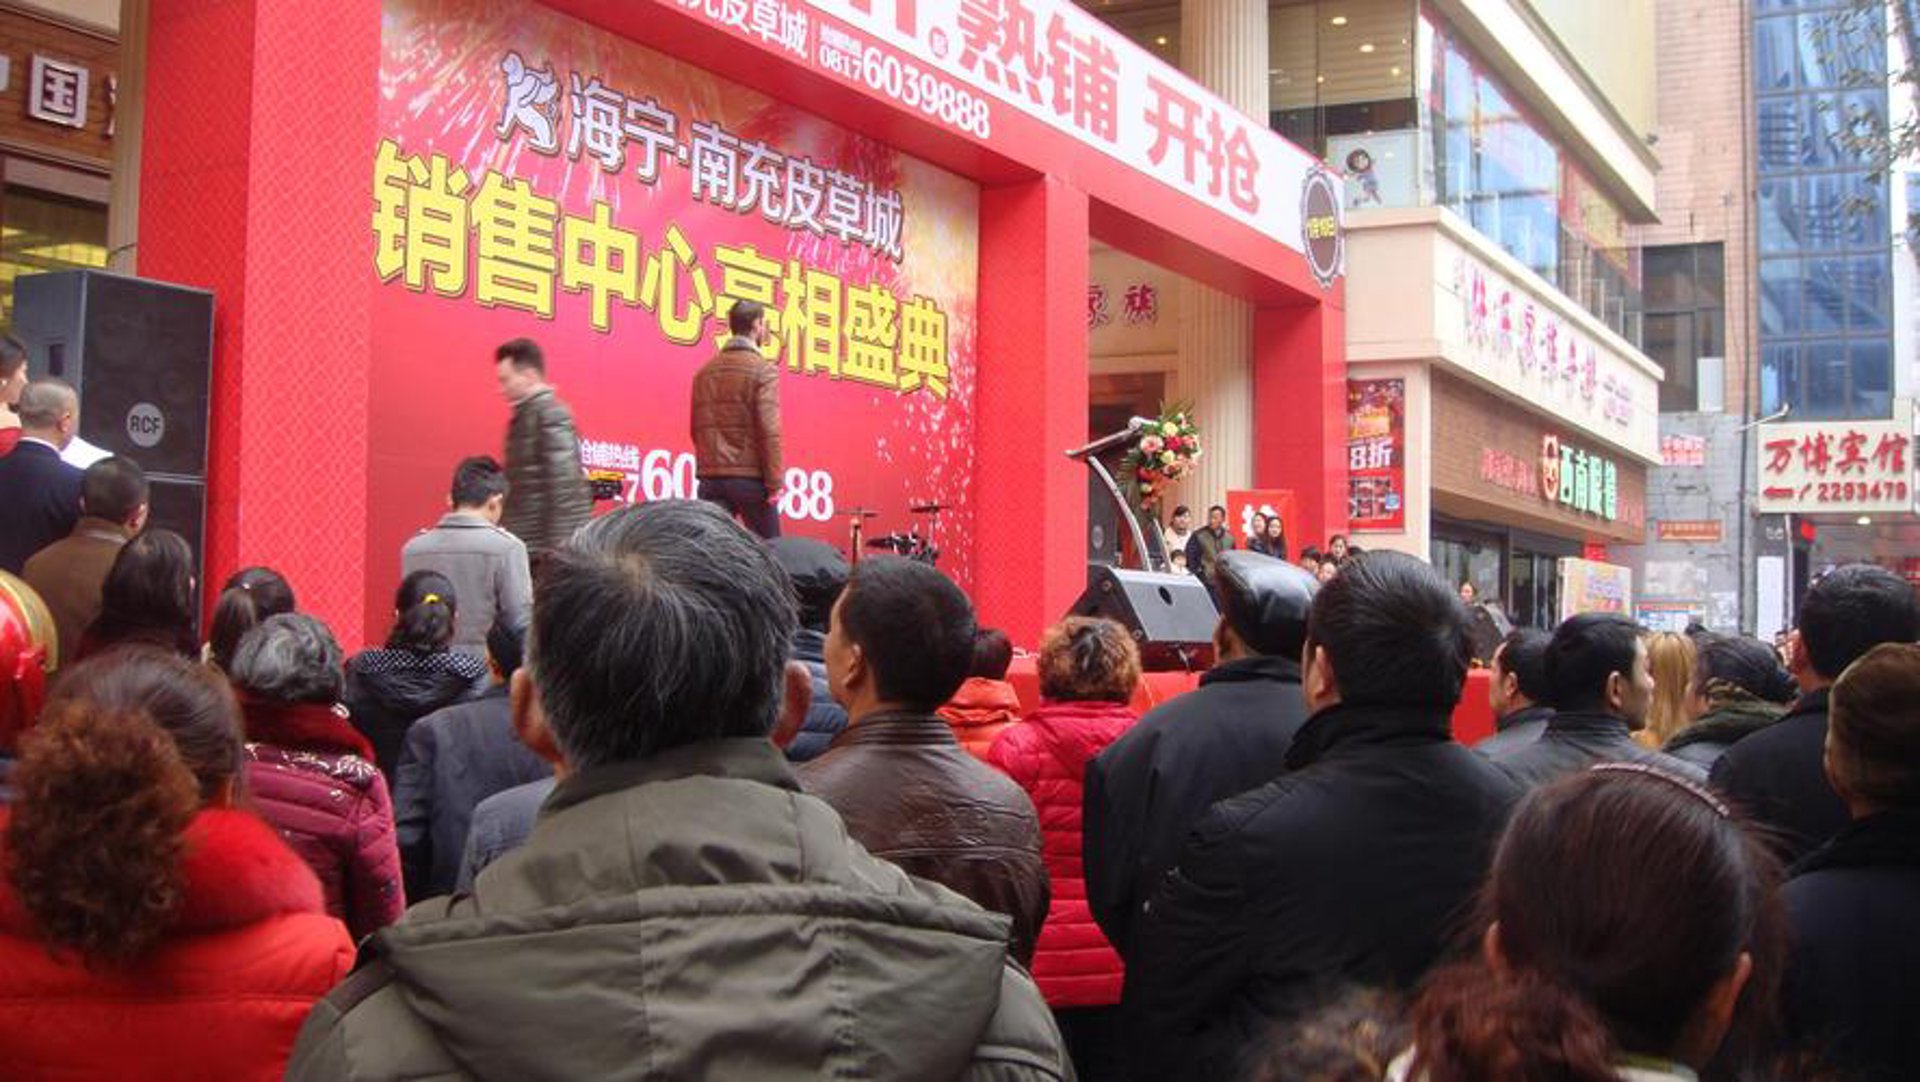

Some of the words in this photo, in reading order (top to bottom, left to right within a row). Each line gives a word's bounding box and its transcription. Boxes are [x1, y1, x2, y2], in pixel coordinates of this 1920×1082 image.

[819, 43, 863, 81] 0817
[862, 46, 991, 139] 6039888
[1143, 73, 1261, 215] 开抢
[371, 138, 951, 400] 销售中心亮相盛典
[130, 415, 160, 434] RCF
